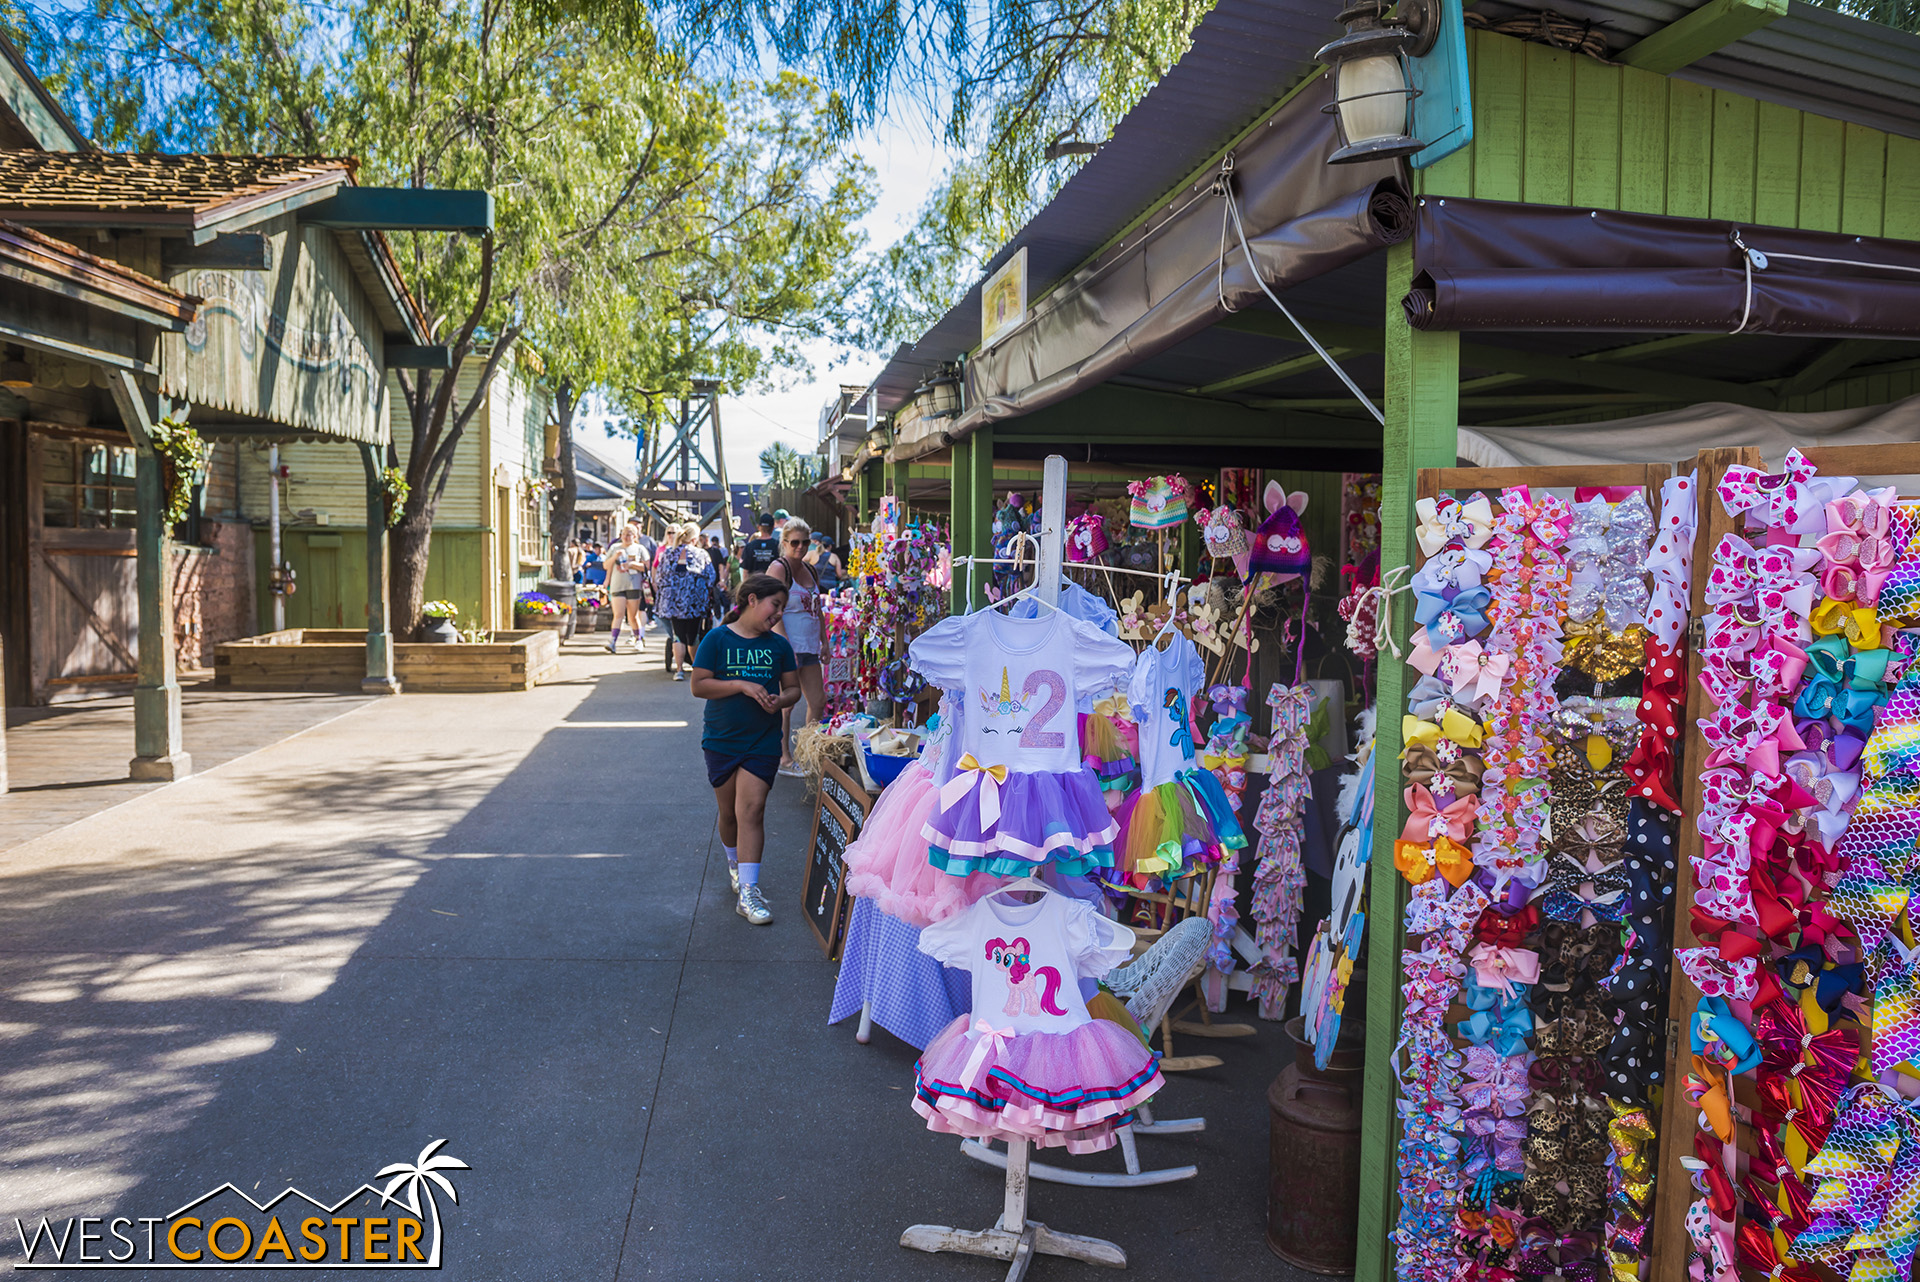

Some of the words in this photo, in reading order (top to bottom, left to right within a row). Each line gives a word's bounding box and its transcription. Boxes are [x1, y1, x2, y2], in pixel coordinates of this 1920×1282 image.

[726, 648, 773, 666] LEAPS
[741, 670, 773, 679] Bounds
[1017, 669, 1067, 749] 2
